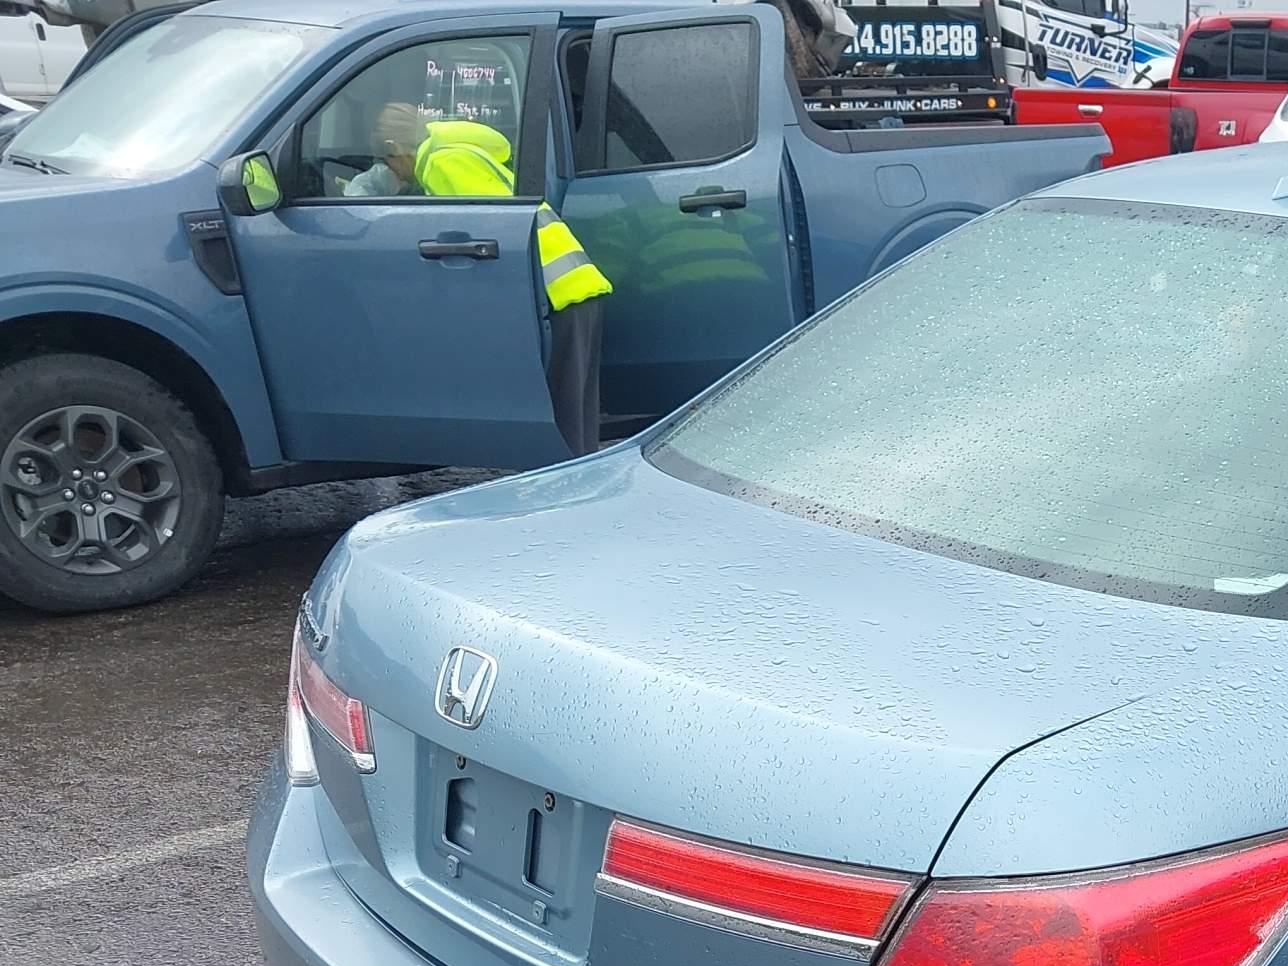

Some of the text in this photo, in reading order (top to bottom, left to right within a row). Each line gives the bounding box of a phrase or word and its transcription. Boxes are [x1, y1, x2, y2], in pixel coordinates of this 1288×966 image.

[843, 23, 977, 56] 14.915.8288
[1038, 23, 1133, 66] TURNER
[1046, 46, 1073, 59] TOWING
[1082, 57, 1117, 71] RECOVERY
[881, 100, 915, 111] JUNK
[921, 99, 957, 110] CARS
[189, 219, 225, 232] XLT
